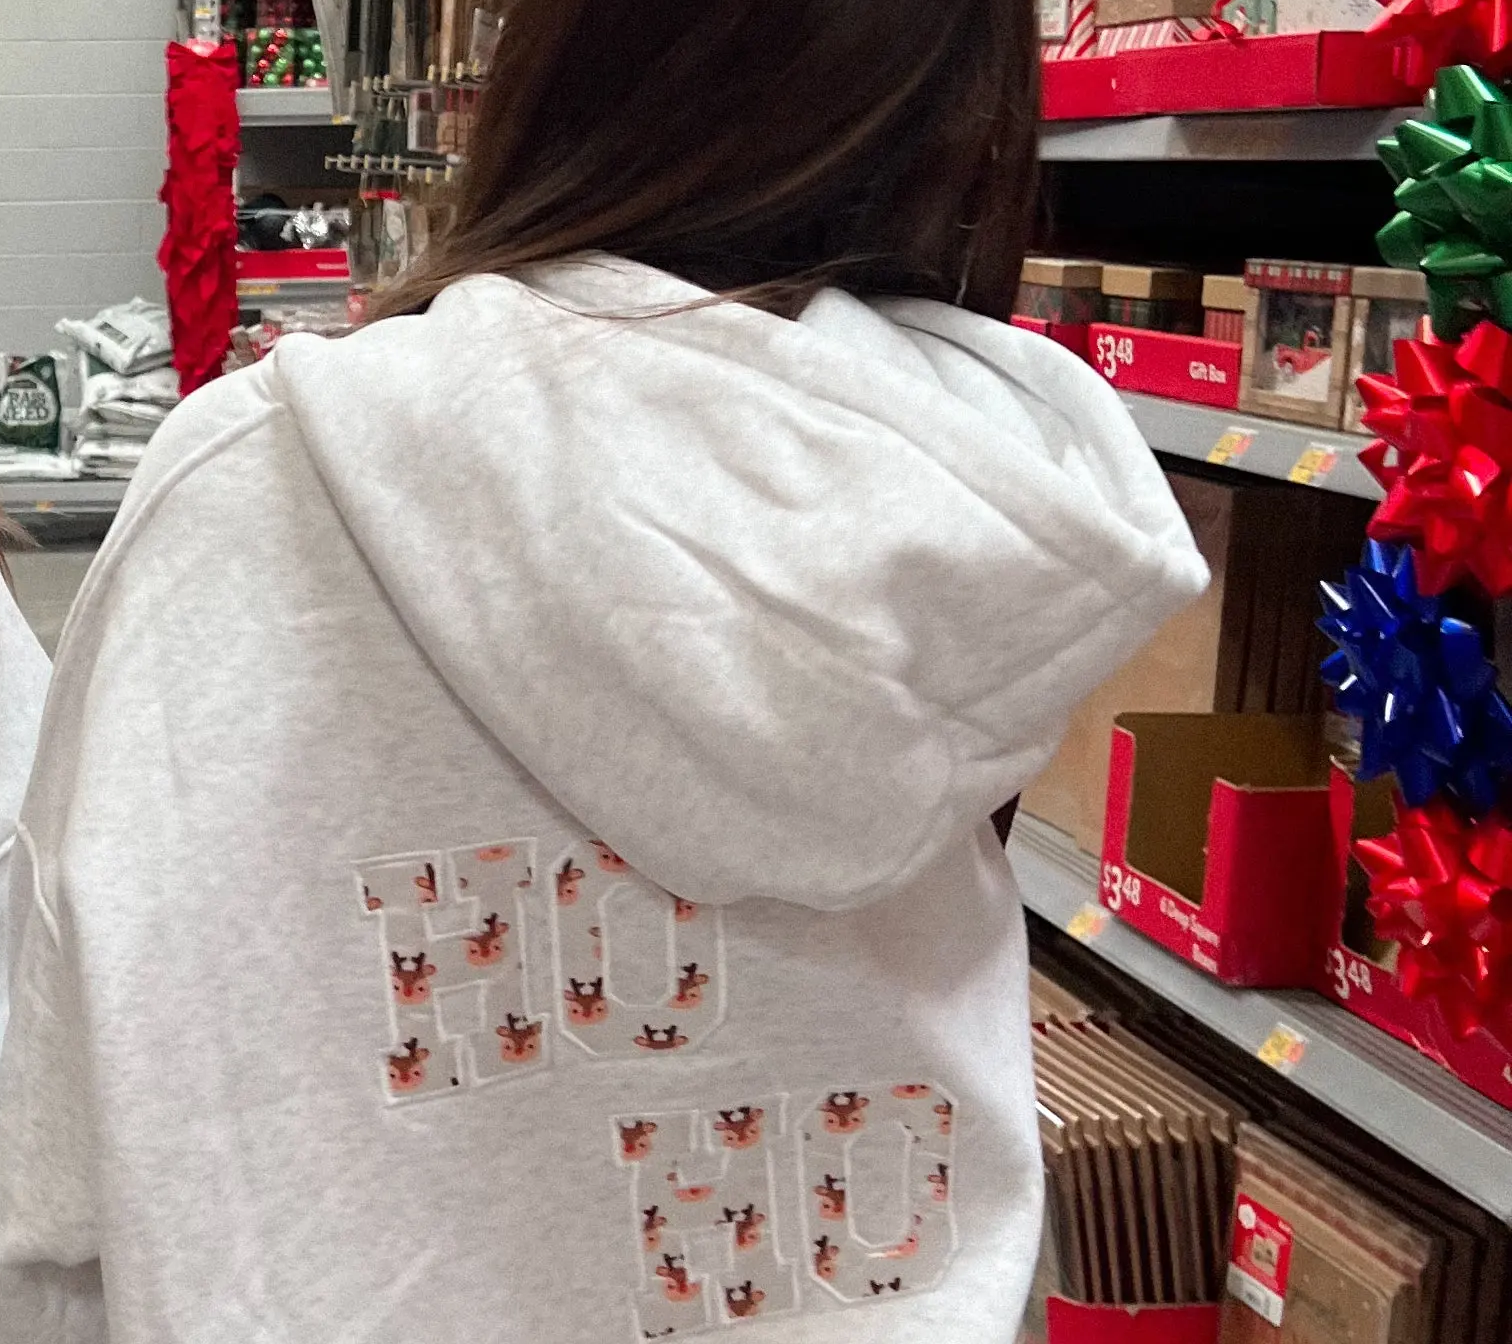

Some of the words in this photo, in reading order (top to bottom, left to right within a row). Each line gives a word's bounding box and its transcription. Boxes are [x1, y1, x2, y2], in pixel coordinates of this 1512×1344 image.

[1096, 333, 1134, 379] $348
[1102, 860, 1141, 911] $348
[352, 836, 728, 1107] HO
